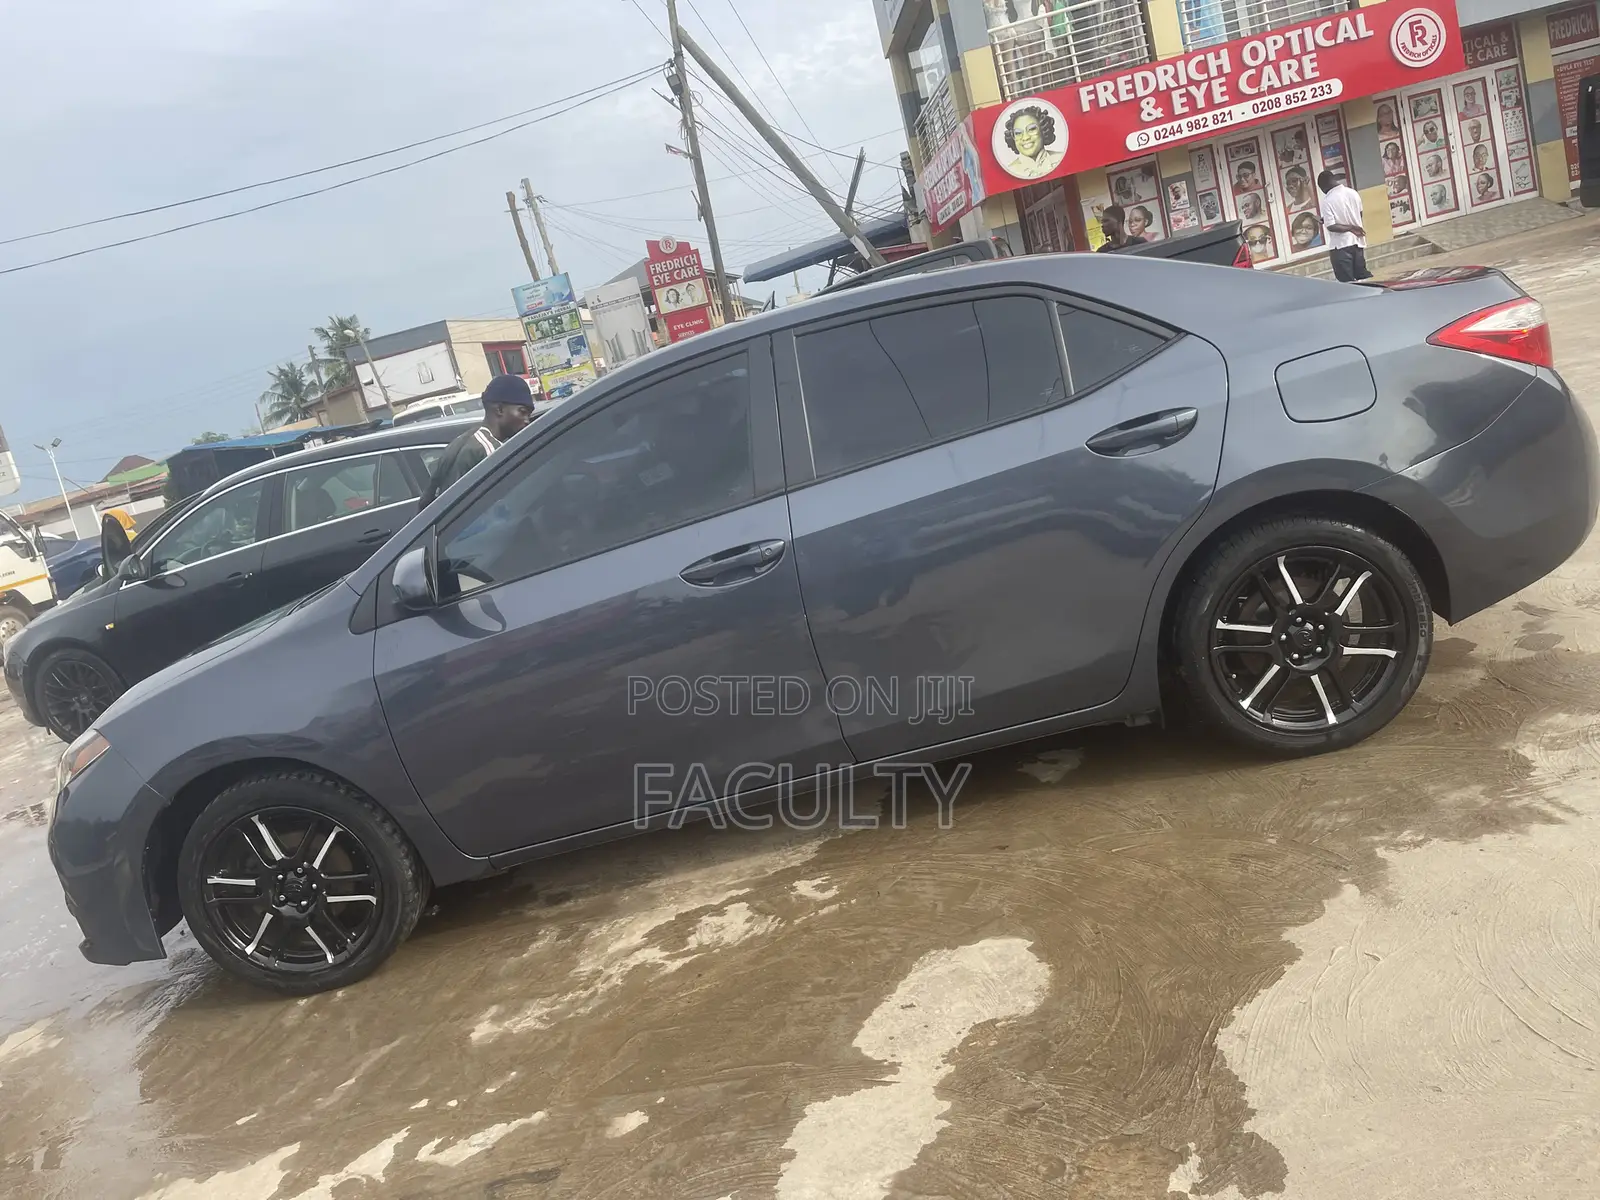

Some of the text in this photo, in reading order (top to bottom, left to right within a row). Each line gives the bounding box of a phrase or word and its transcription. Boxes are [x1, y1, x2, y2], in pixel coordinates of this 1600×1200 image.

[1549, 14, 1594, 41] FREDRICH
[1079, 12, 1374, 113] FREDRICH OPTICAL
[1476, 43, 1508, 62] CARE
[1140, 52, 1320, 122] & EYE CARE
[1154, 124, 1184, 141] 0244
[1186, 117, 1209, 132] 982
[1212, 110, 1234, 125] 821
[1252, 97, 1282, 115] 0208
[1285, 90, 1308, 106] 852
[1310, 83, 1333, 99] 233
[649, 253, 698, 275] FREDRICH
[652, 265, 701, 286] EYE CARE
[673, 318, 705, 331] EYE CLINIC
